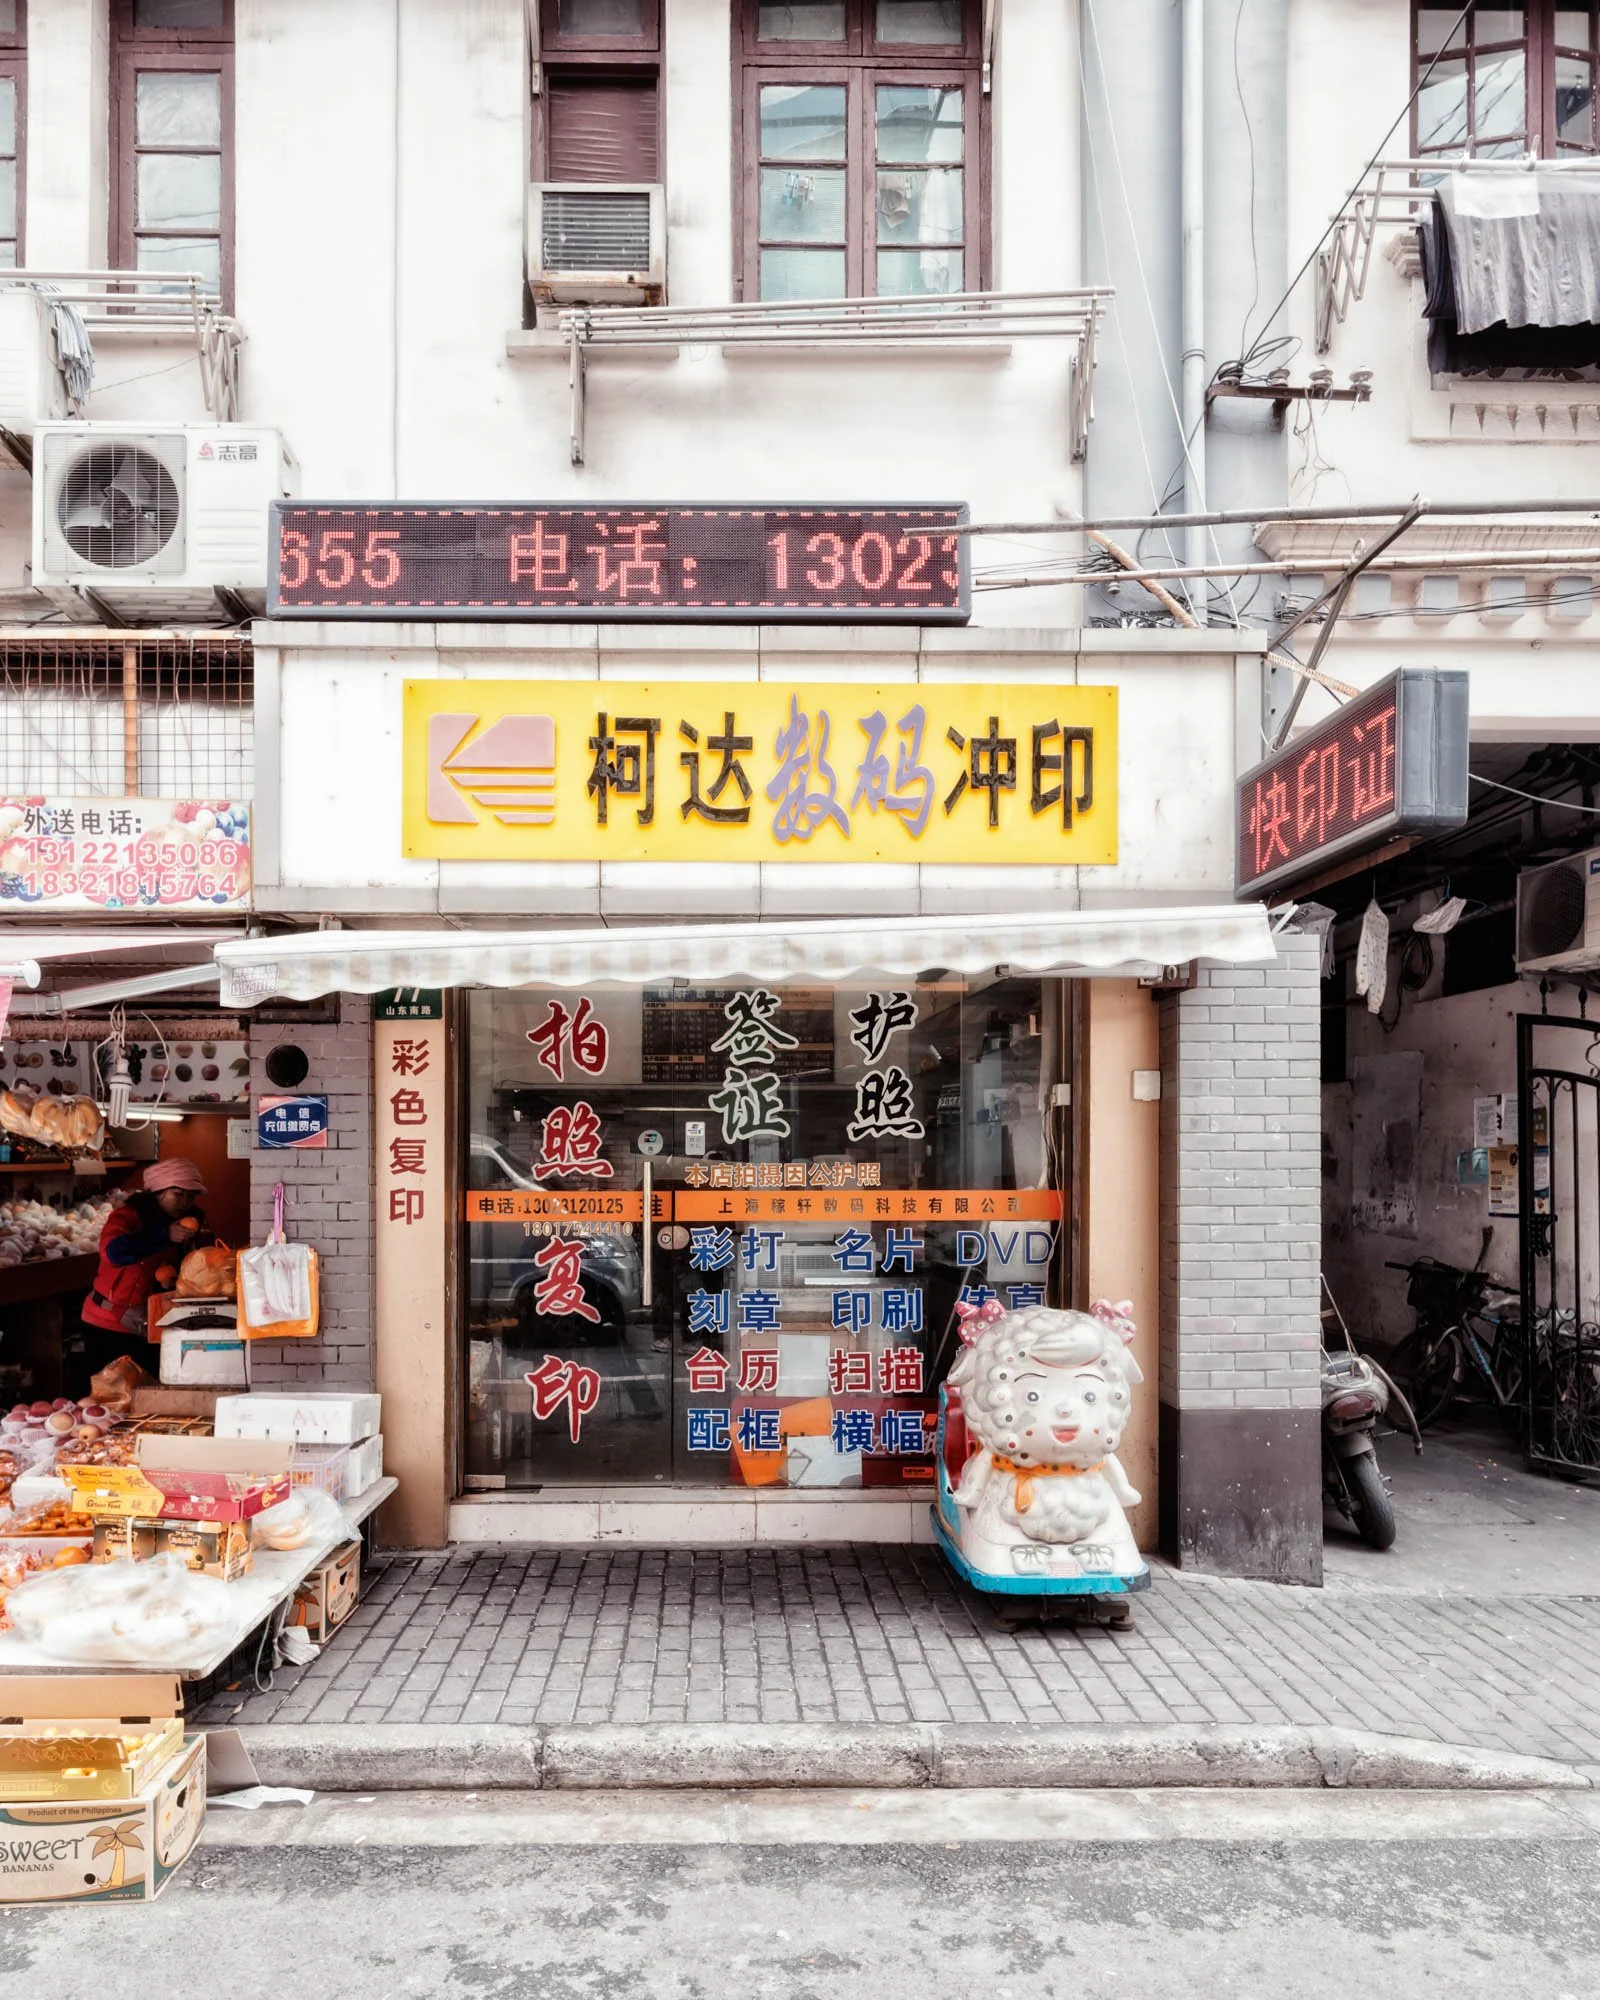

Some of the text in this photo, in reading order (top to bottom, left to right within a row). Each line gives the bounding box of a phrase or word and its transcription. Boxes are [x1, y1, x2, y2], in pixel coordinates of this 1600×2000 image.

[218, 444, 257, 461] 志高
[587, 692, 1096, 844] 柯达数码冲印
[24, 808, 142, 836] 外送电话:
[24, 840, 237, 866] 13122135086
[23, 871, 237, 897] 18321815764
[385, 1005, 432, 1017] 山东南路
[389, 1038, 430, 1226] 彩色复印
[684, 1162, 882, 1188] 本店拍摄因公护照
[689, 1225, 1055, 1272] 彩打 名片 DVD
[686, 1288, 782, 1333] 刻章
[831, 1287, 923, 1333] 印刷
[685, 1347, 925, 1394] 台历 扫描
[686, 1407, 782, 1452] 配框
[831, 1409, 925, 1455] 横幅
[28, 1808, 57, 1816] Product
[68, 1807, 80, 1815] the
[81, 1806, 122, 1816] Philippines
[2, 1863, 55, 1873] BANANAS
